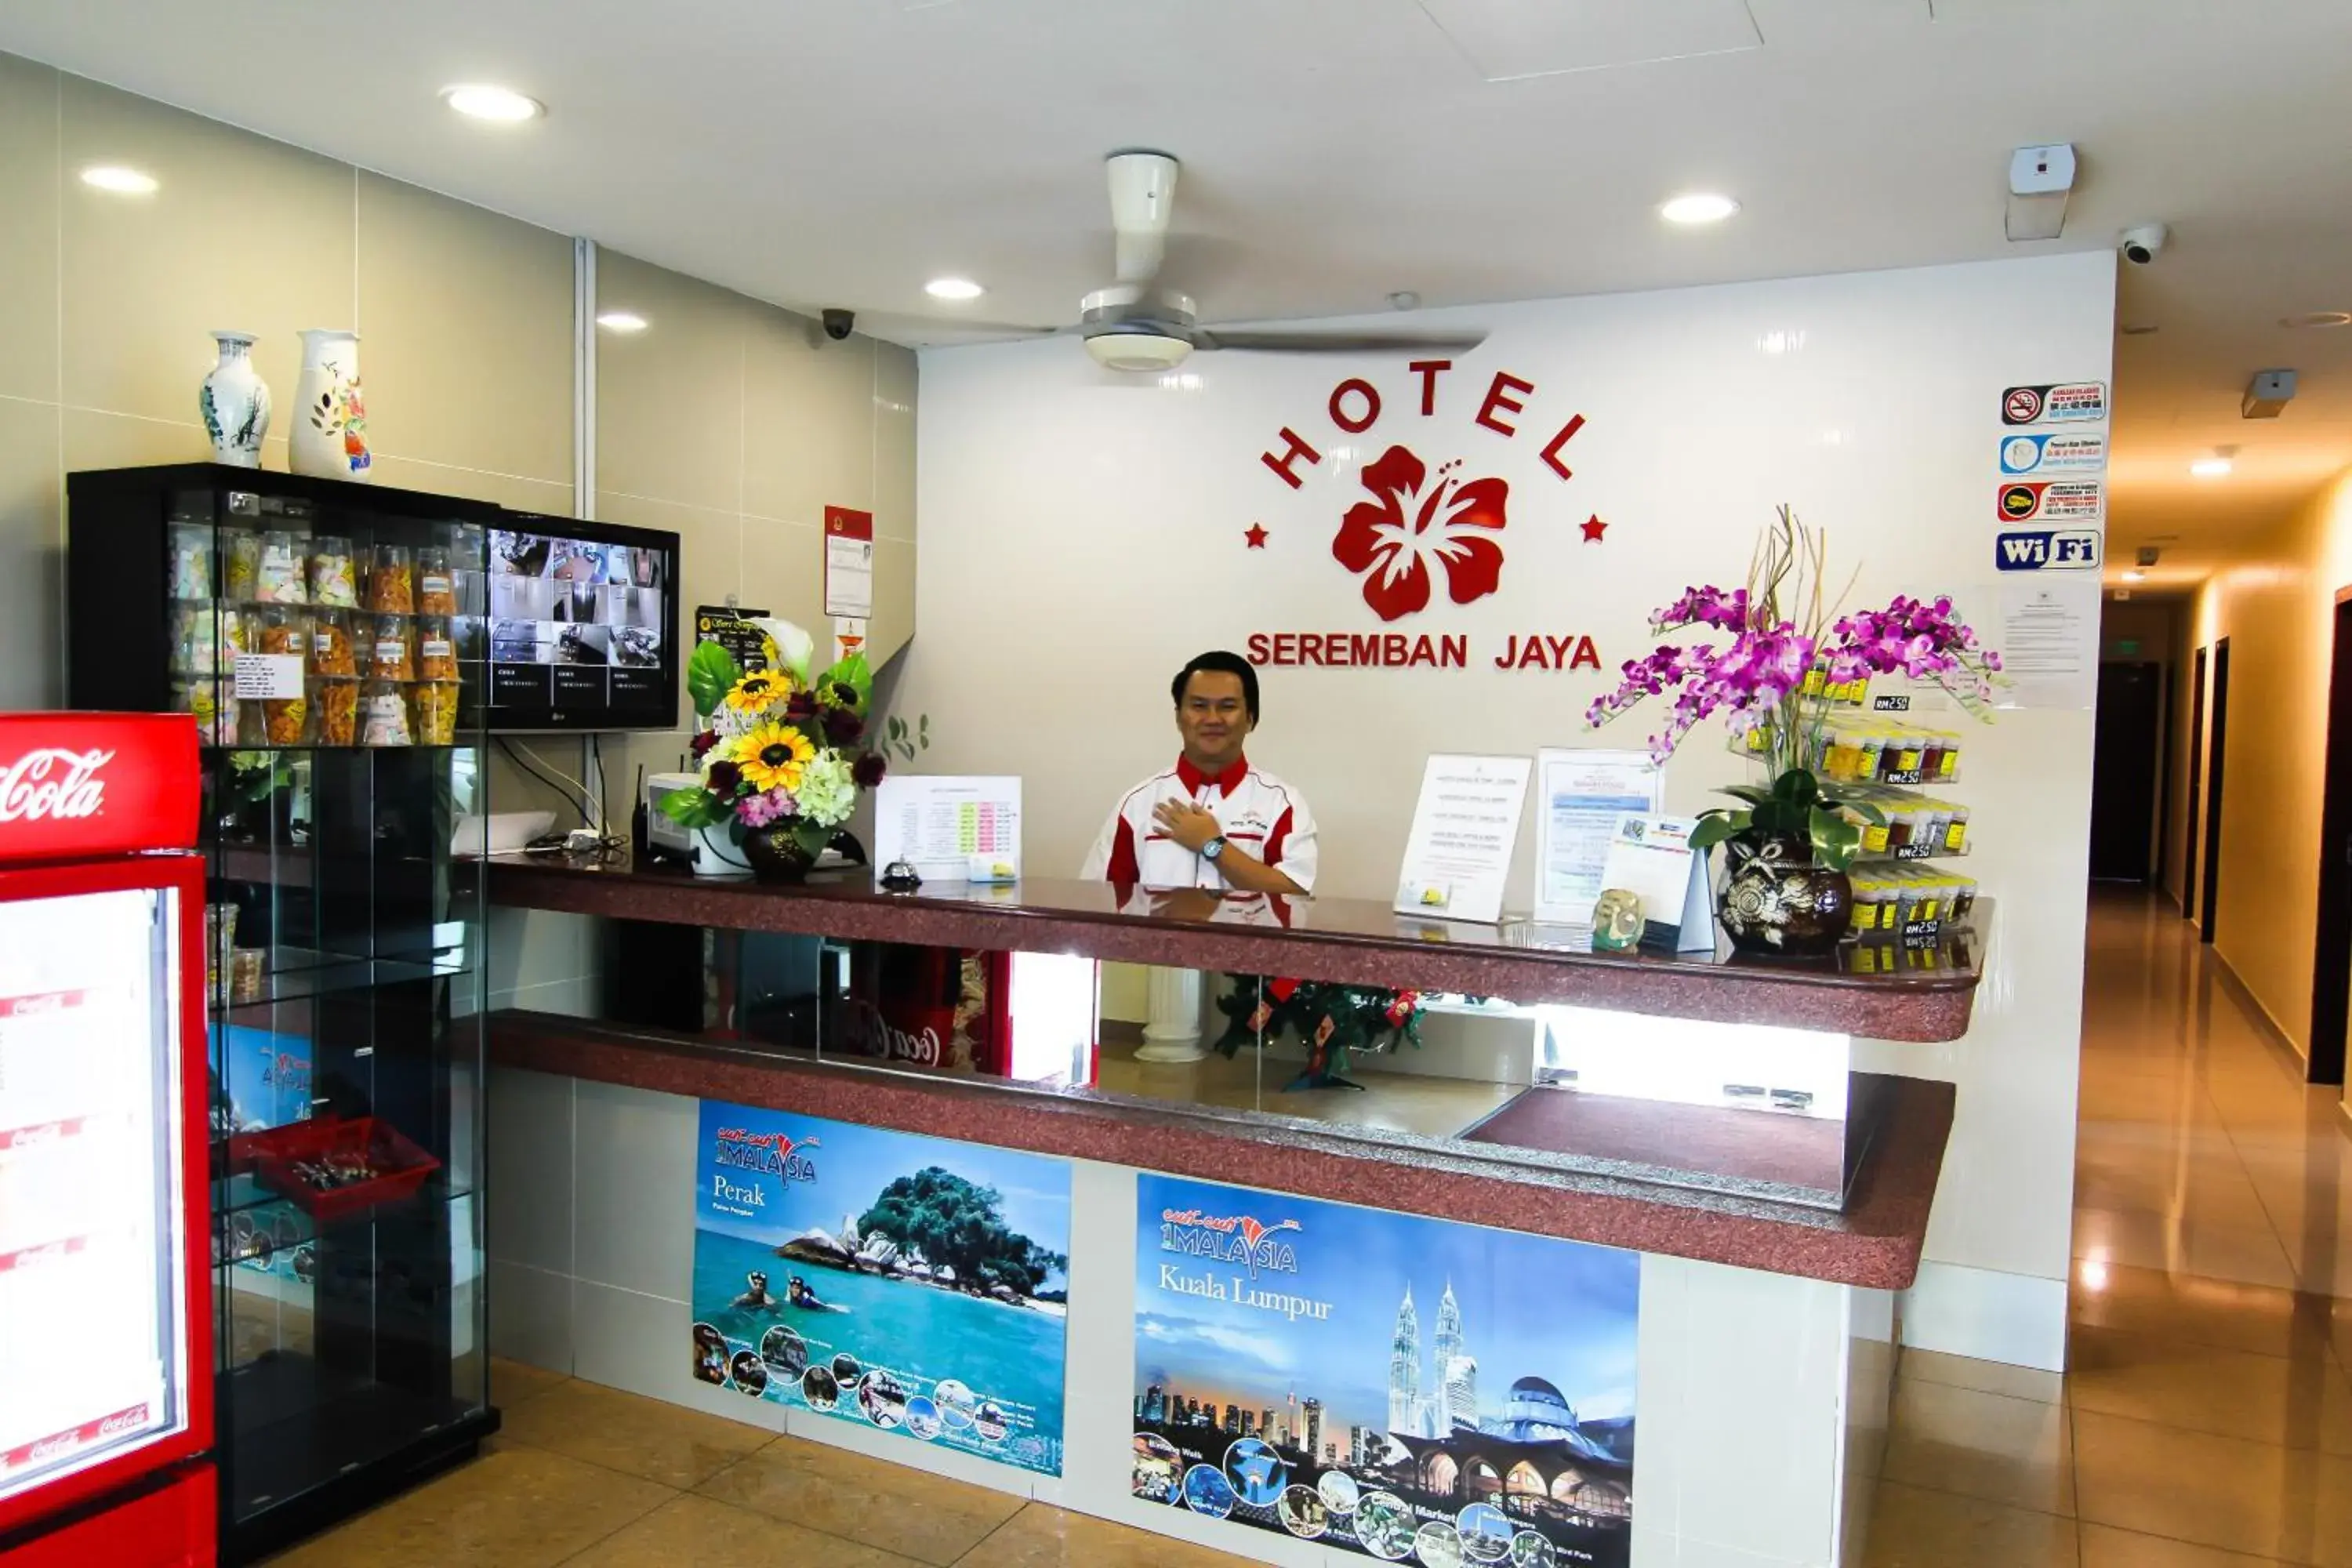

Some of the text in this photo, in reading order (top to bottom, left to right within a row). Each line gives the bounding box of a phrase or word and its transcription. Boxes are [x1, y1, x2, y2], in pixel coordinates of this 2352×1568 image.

[1261, 360, 1586, 490] HOTEL
[1247, 633, 1602, 671] SEREMBAN JAYA
[1876, 697, 1907, 710] RM2.50
[1888, 770, 1919, 783] RM2.50
[1898, 845, 1930, 858] RM2.50
[1906, 921, 1938, 934] RM2.50
[713, 1175, 765, 1207] Perak
[1158, 1264, 1333, 1322] Kuala Lumpur
[1181, 1446, 1203, 1460] Walk
[1414, 1504, 1457, 1523] Market
